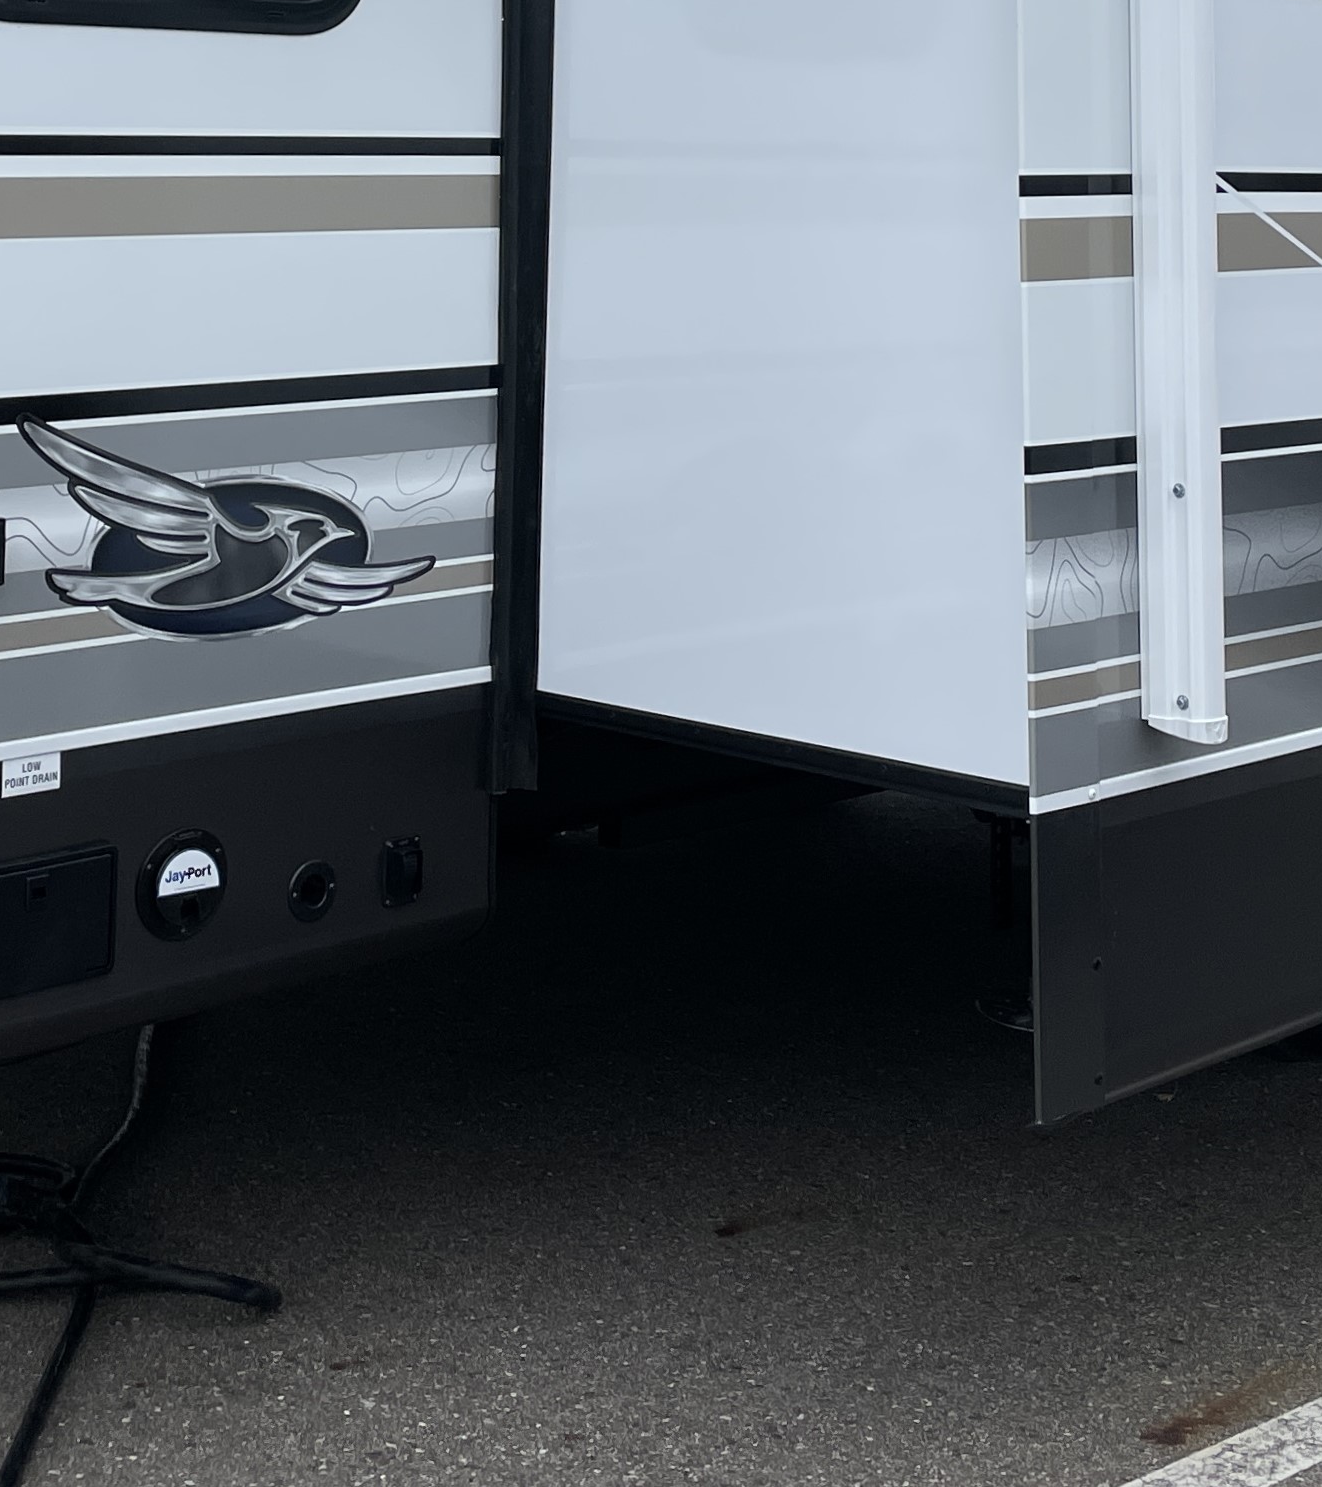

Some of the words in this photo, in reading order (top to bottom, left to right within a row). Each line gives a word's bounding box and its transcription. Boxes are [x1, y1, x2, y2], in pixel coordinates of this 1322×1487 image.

[21, 760, 42, 774] LOW
[4, 775, 30, 790] POINT
[31, 771, 59, 785] DRAIN
